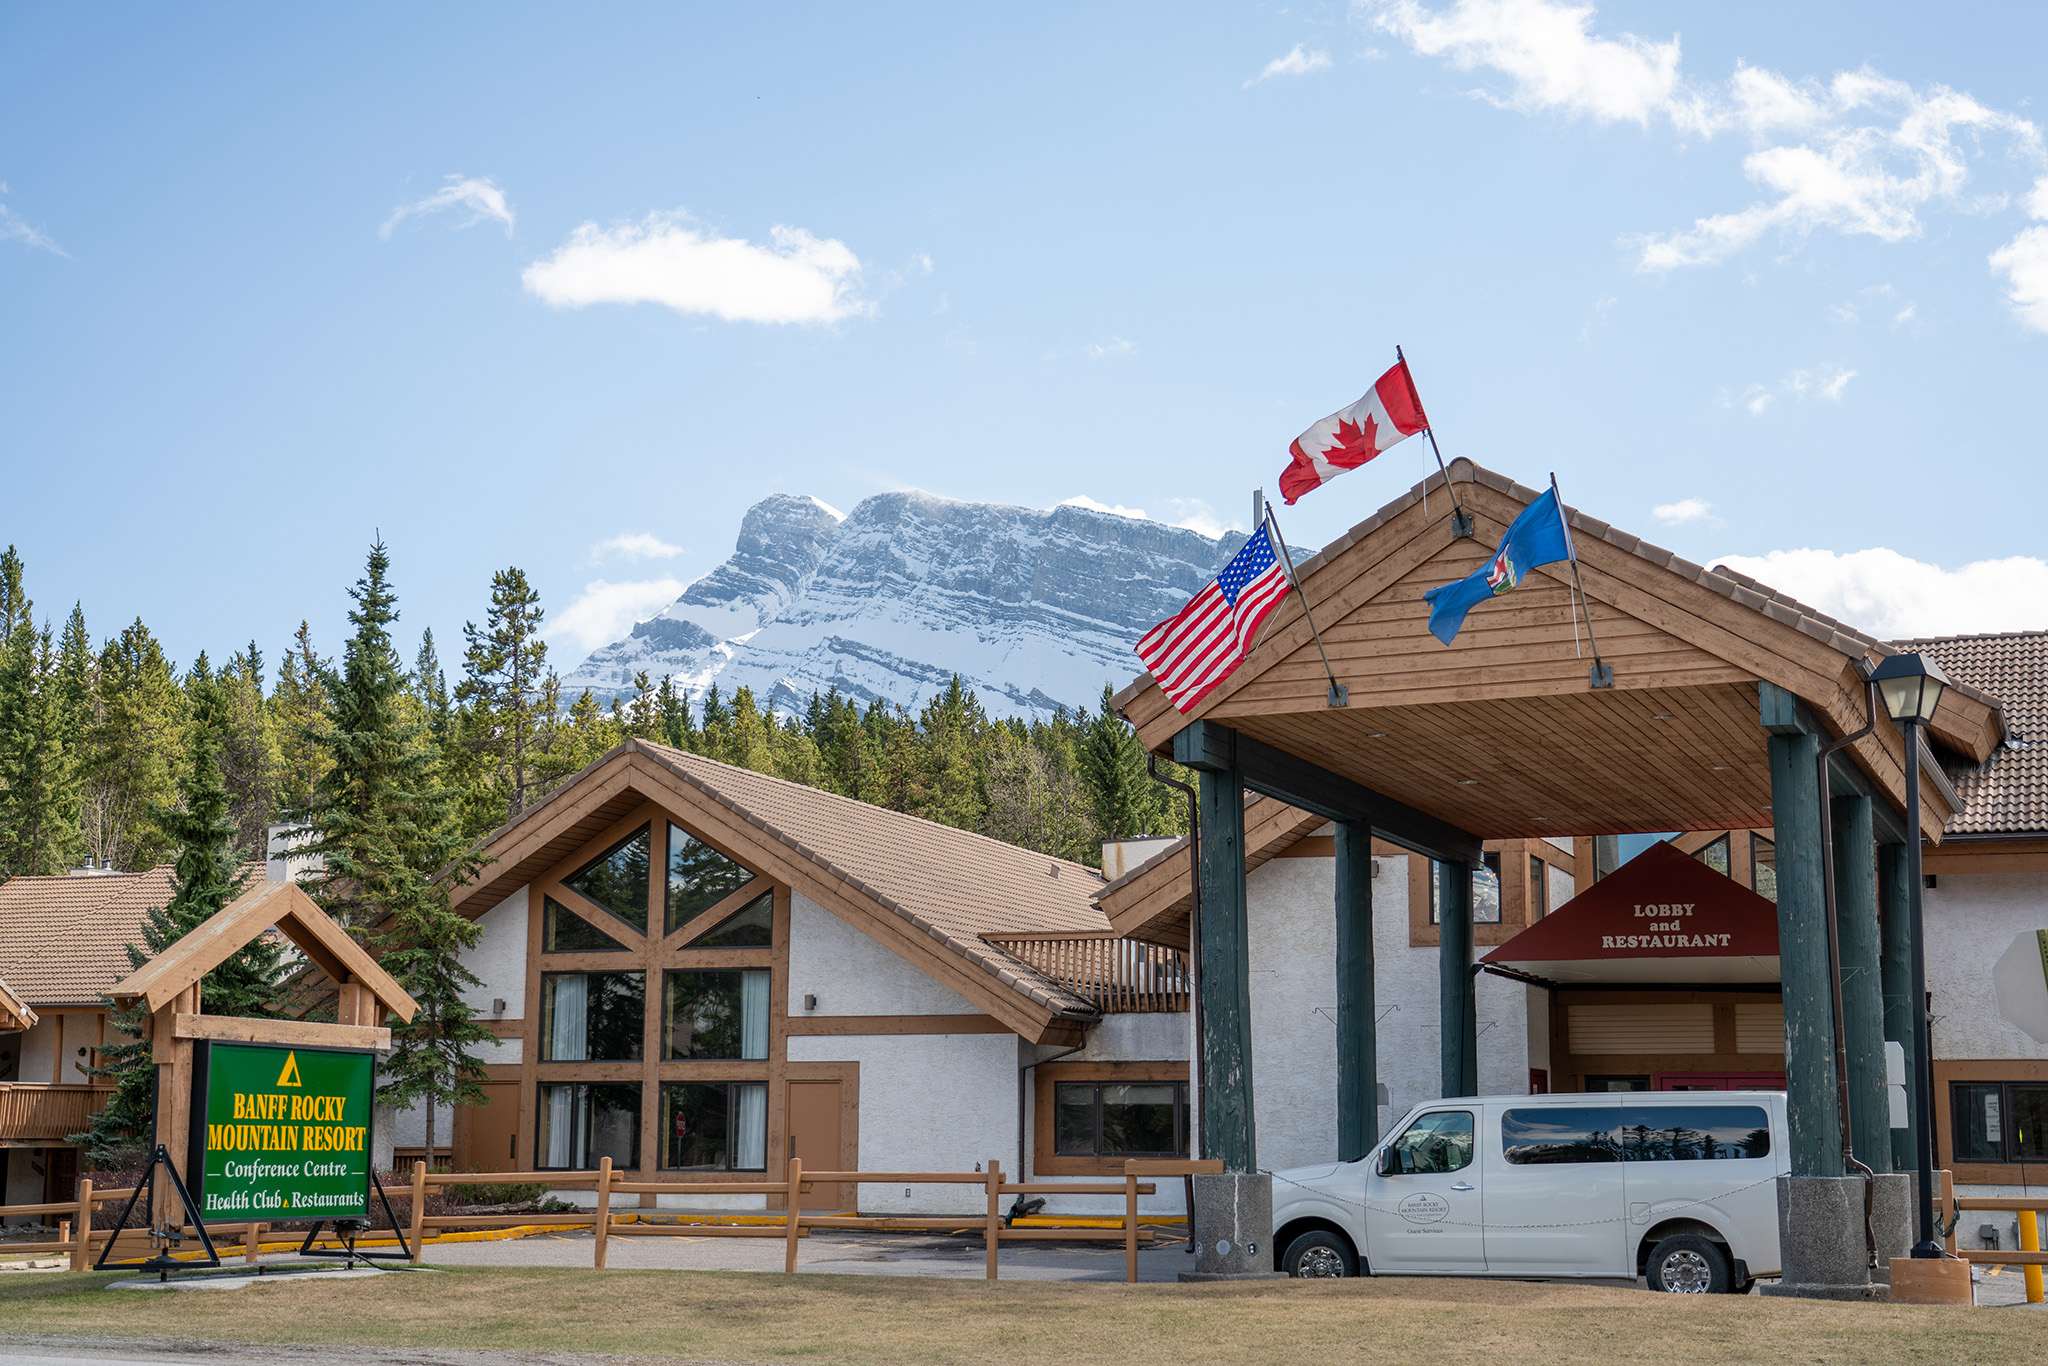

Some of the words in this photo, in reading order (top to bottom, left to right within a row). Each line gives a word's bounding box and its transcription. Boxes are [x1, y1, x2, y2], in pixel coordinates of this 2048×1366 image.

[1634, 903, 1695, 917] LOBBY
[1649, 920, 1680, 931] and
[1602, 934, 1731, 948] RESTAURANT
[233, 1093, 288, 1120] BANFF
[290, 1095, 346, 1121] ROCKY
[207, 1124, 299, 1151] MOUNTAIN
[302, 1126, 366, 1151] RESORT
[224, 1158, 300, 1185] Conference
[304, 1160, 347, 1177] Centre
[206, 1190, 250, 1210] Health
[252, 1190, 282, 1209] Club
[291, 1191, 364, 1208] Restaurants
